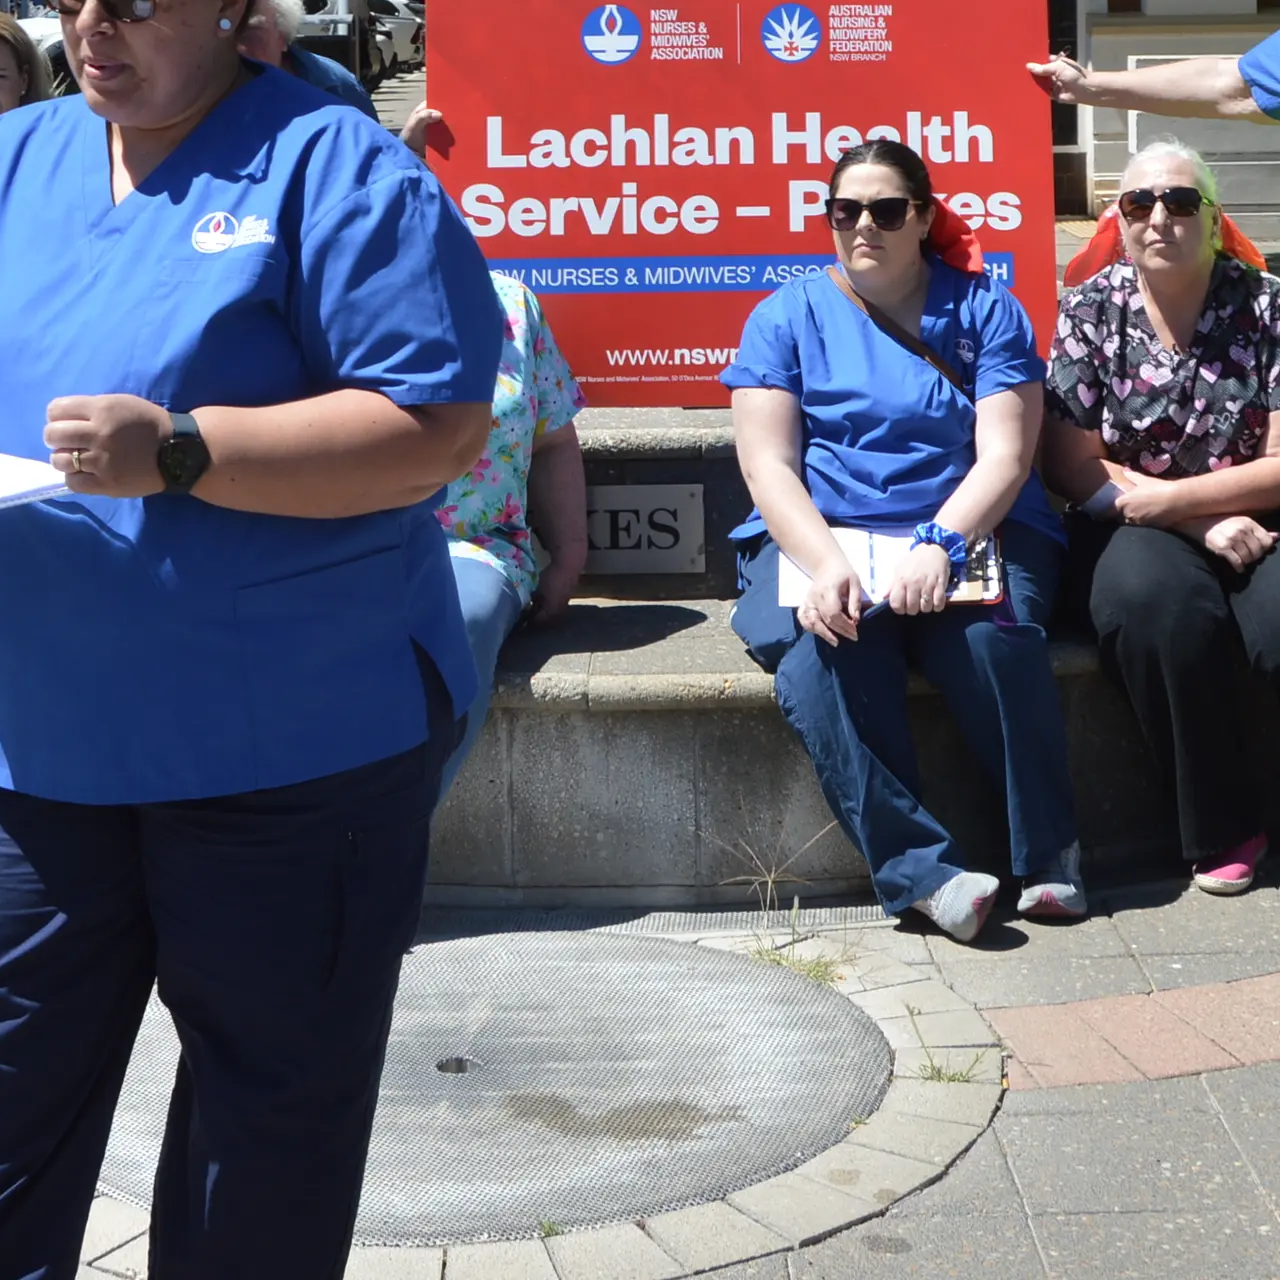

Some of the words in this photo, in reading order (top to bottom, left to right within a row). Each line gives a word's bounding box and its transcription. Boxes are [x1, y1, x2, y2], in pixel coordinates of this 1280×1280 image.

[650, 9, 678, 21] NSW
[828, 4, 893, 16] AUSTRALIAN
[650, 21, 696, 34] NURSES
[698, 21, 707, 33] &
[829, 16, 875, 28] NURSING
[876, 16, 886, 28] &
[829, 28, 887, 40] MIDWIFERY
[650, 34, 710, 47] MIDWIVES'
[829, 40, 892, 52] FEDERATION
[650, 47, 724, 60] ASSOCIATION
[829, 53, 849, 61] NSW
[850, 53, 886, 61] BRANCH
[486, 113, 755, 168] Lachlan
[460, 181, 720, 238] Service
[788, 179, 1022, 233] Pes
[531, 268, 618, 286] NURSES
[625, 268, 639, 285] &
